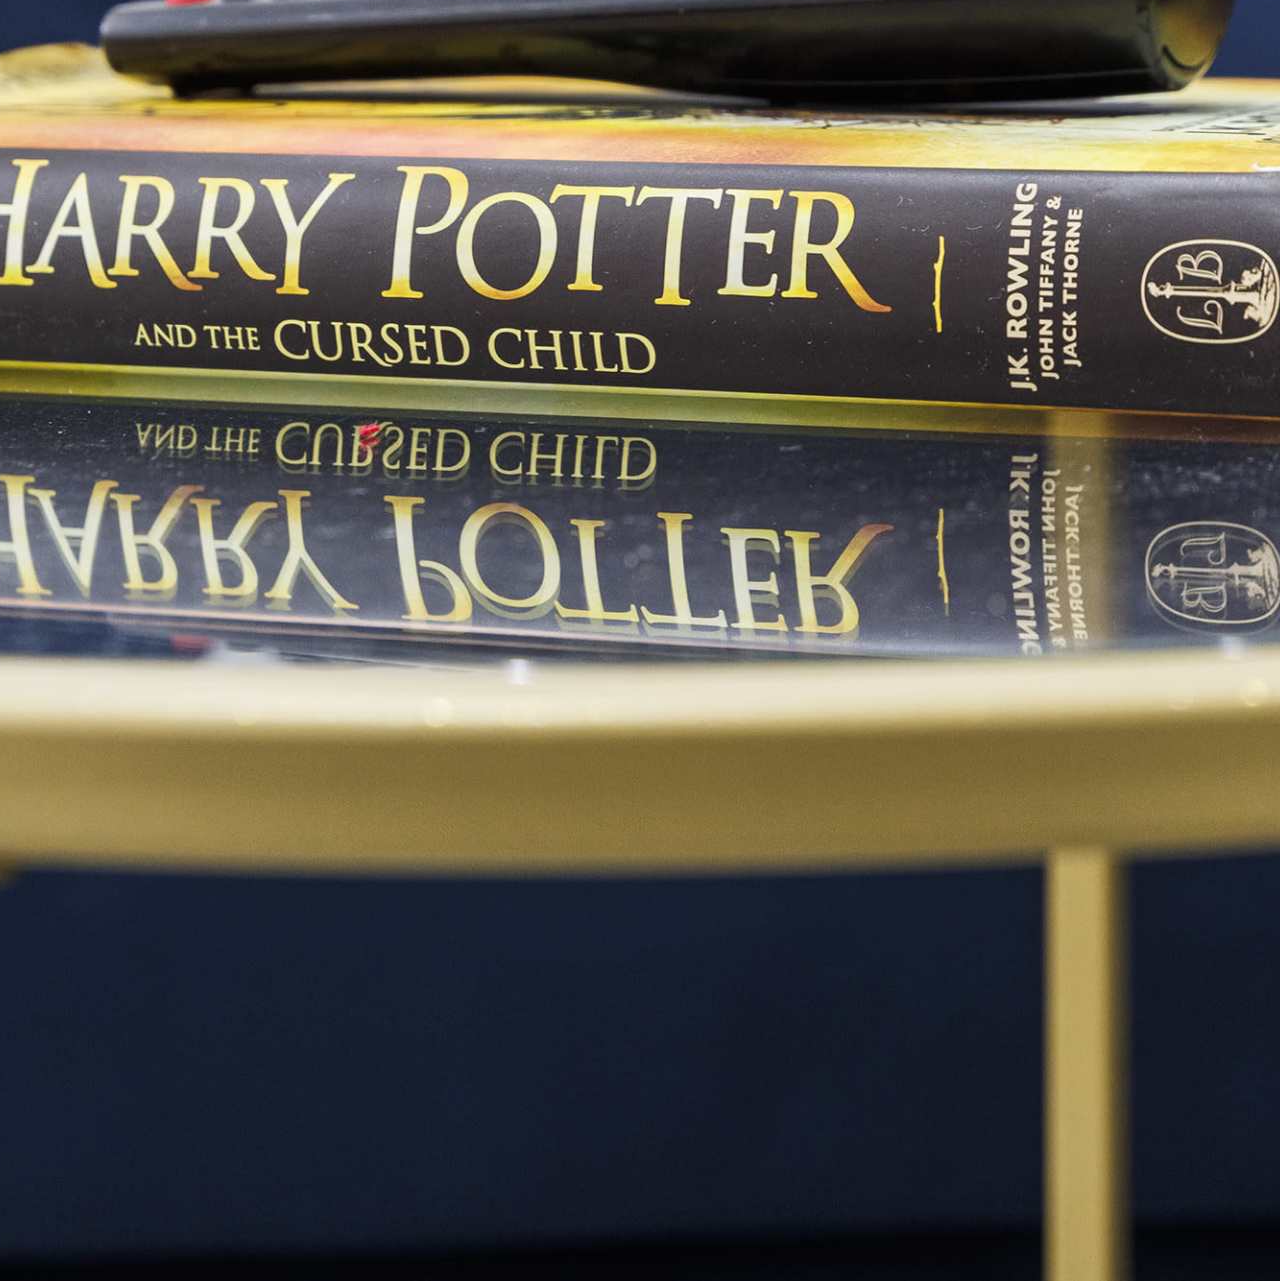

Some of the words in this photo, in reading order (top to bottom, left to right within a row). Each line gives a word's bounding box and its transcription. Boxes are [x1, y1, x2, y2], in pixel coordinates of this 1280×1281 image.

[1046, 195, 1062, 210] &
[381, 165, 892, 313] POTTER
[1006, 183, 1038, 338] ROWLING
[1039, 215, 1058, 312] TIFFANY
[1062, 208, 1083, 304] THORNE
[134, 323, 197, 348] AND
[203, 325, 260, 351] THE
[274, 319, 471, 367] CURSED
[487, 327, 657, 374] CHILD
[1007, 347, 1037, 392] J.K.
[1039, 319, 1060, 380] JOHN
[1062, 311, 1082, 367] JACK
